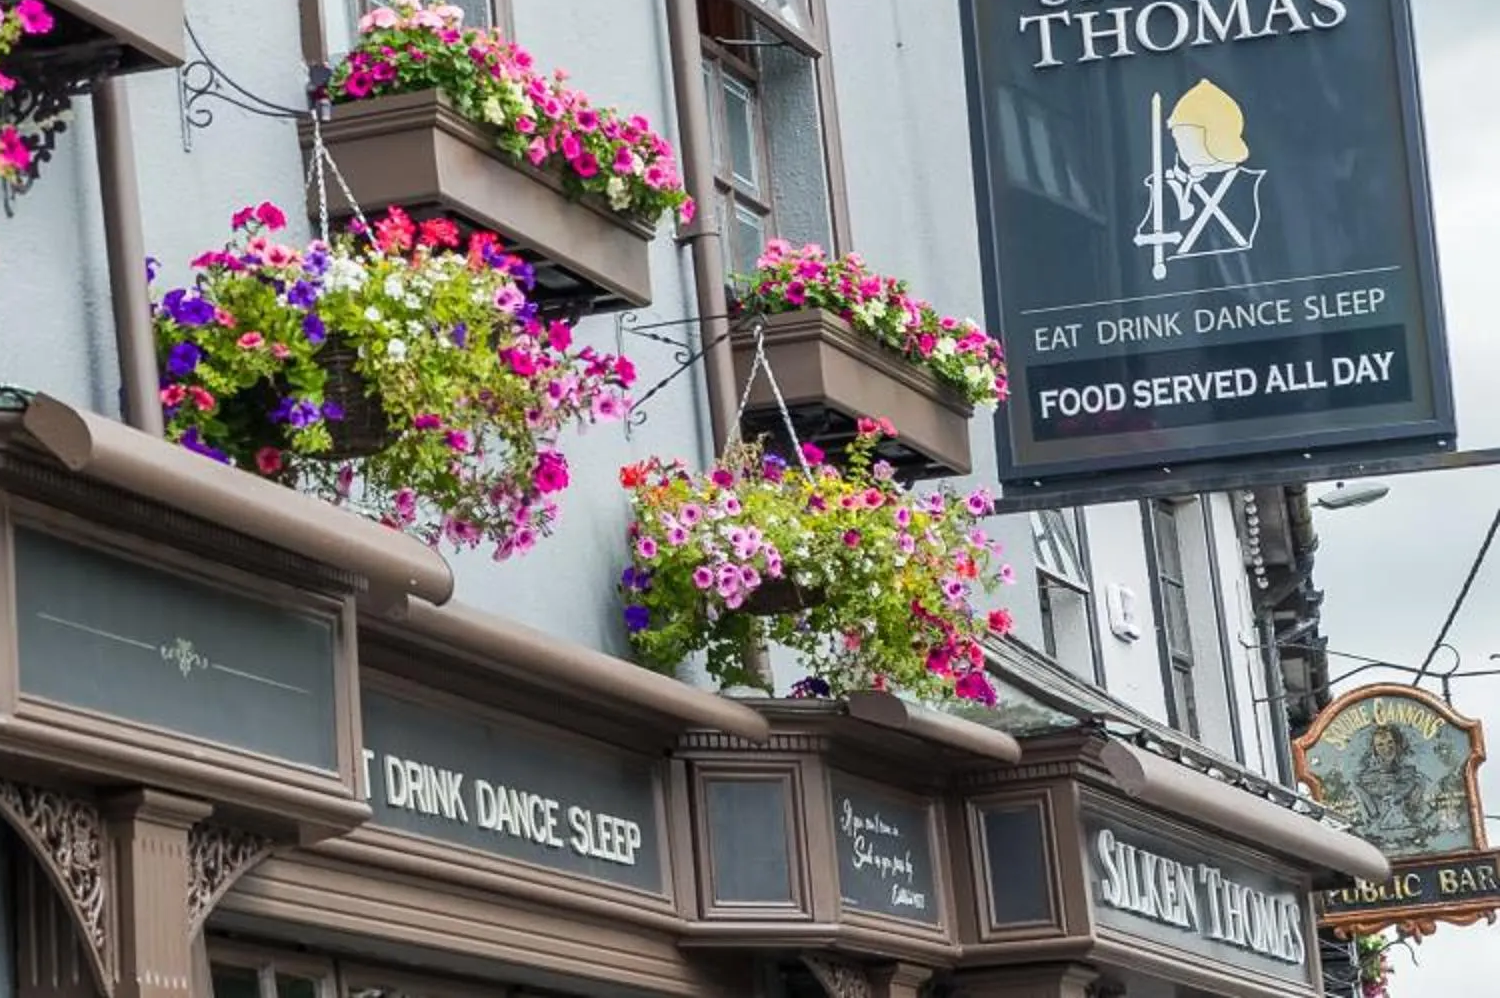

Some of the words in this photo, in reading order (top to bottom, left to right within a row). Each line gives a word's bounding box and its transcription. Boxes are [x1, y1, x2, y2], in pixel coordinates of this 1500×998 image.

[1035, 323, 1082, 352] EAT
[1097, 311, 1182, 345] DRINK
[1195, 299, 1292, 334] DANCE
[1304, 288, 1385, 322] SLEEP
[1039, 382, 1126, 419] FOOD
[1132, 365, 1257, 409] SERVED
[1265, 360, 1327, 394] ALL
[1332, 351, 1395, 388] DAY
[384, 753, 468, 823] DRINK
[475, 778, 563, 848] DANCE
[567, 805, 641, 865] SLEEP
[1098, 828, 1200, 934] SILKEN
[1200, 863, 1305, 965] THOMAS
[1438, 865, 1497, 894] BAR
